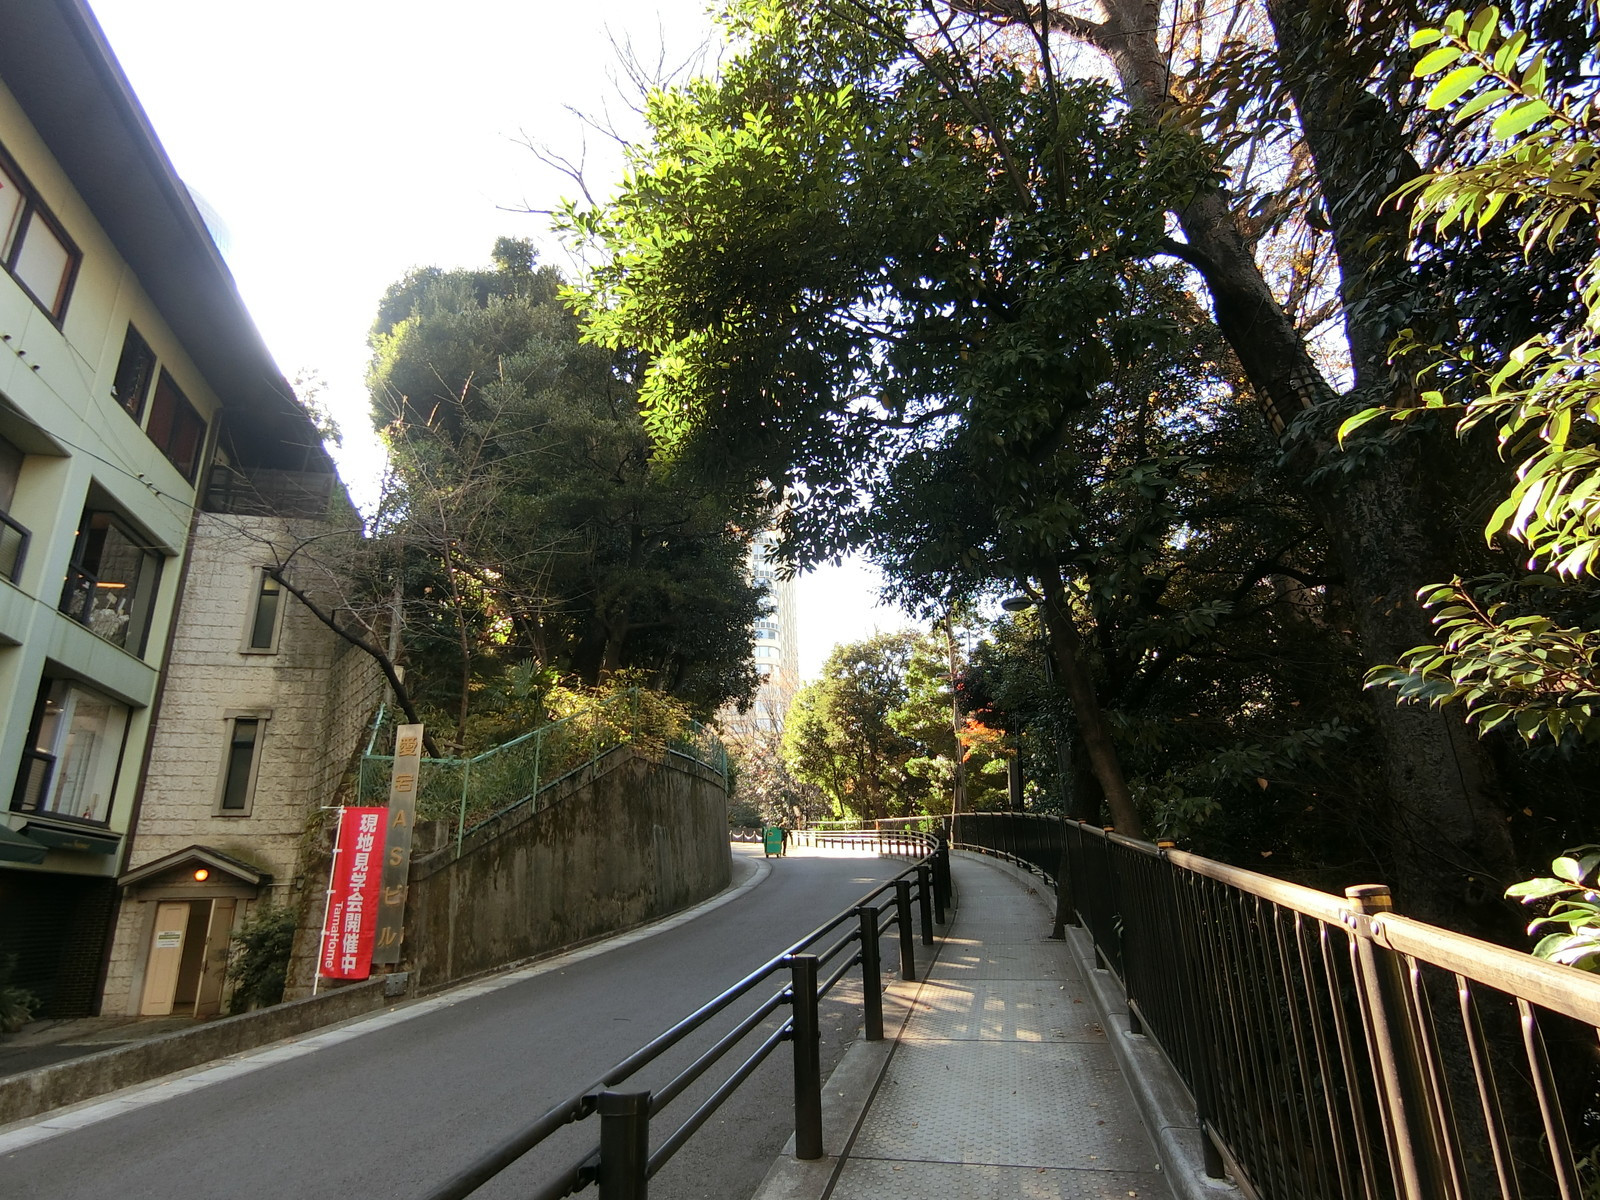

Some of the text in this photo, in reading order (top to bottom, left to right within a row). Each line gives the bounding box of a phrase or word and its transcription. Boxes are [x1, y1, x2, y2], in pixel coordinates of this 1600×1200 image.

[341, 814, 378, 974] 現地見学会開催中
